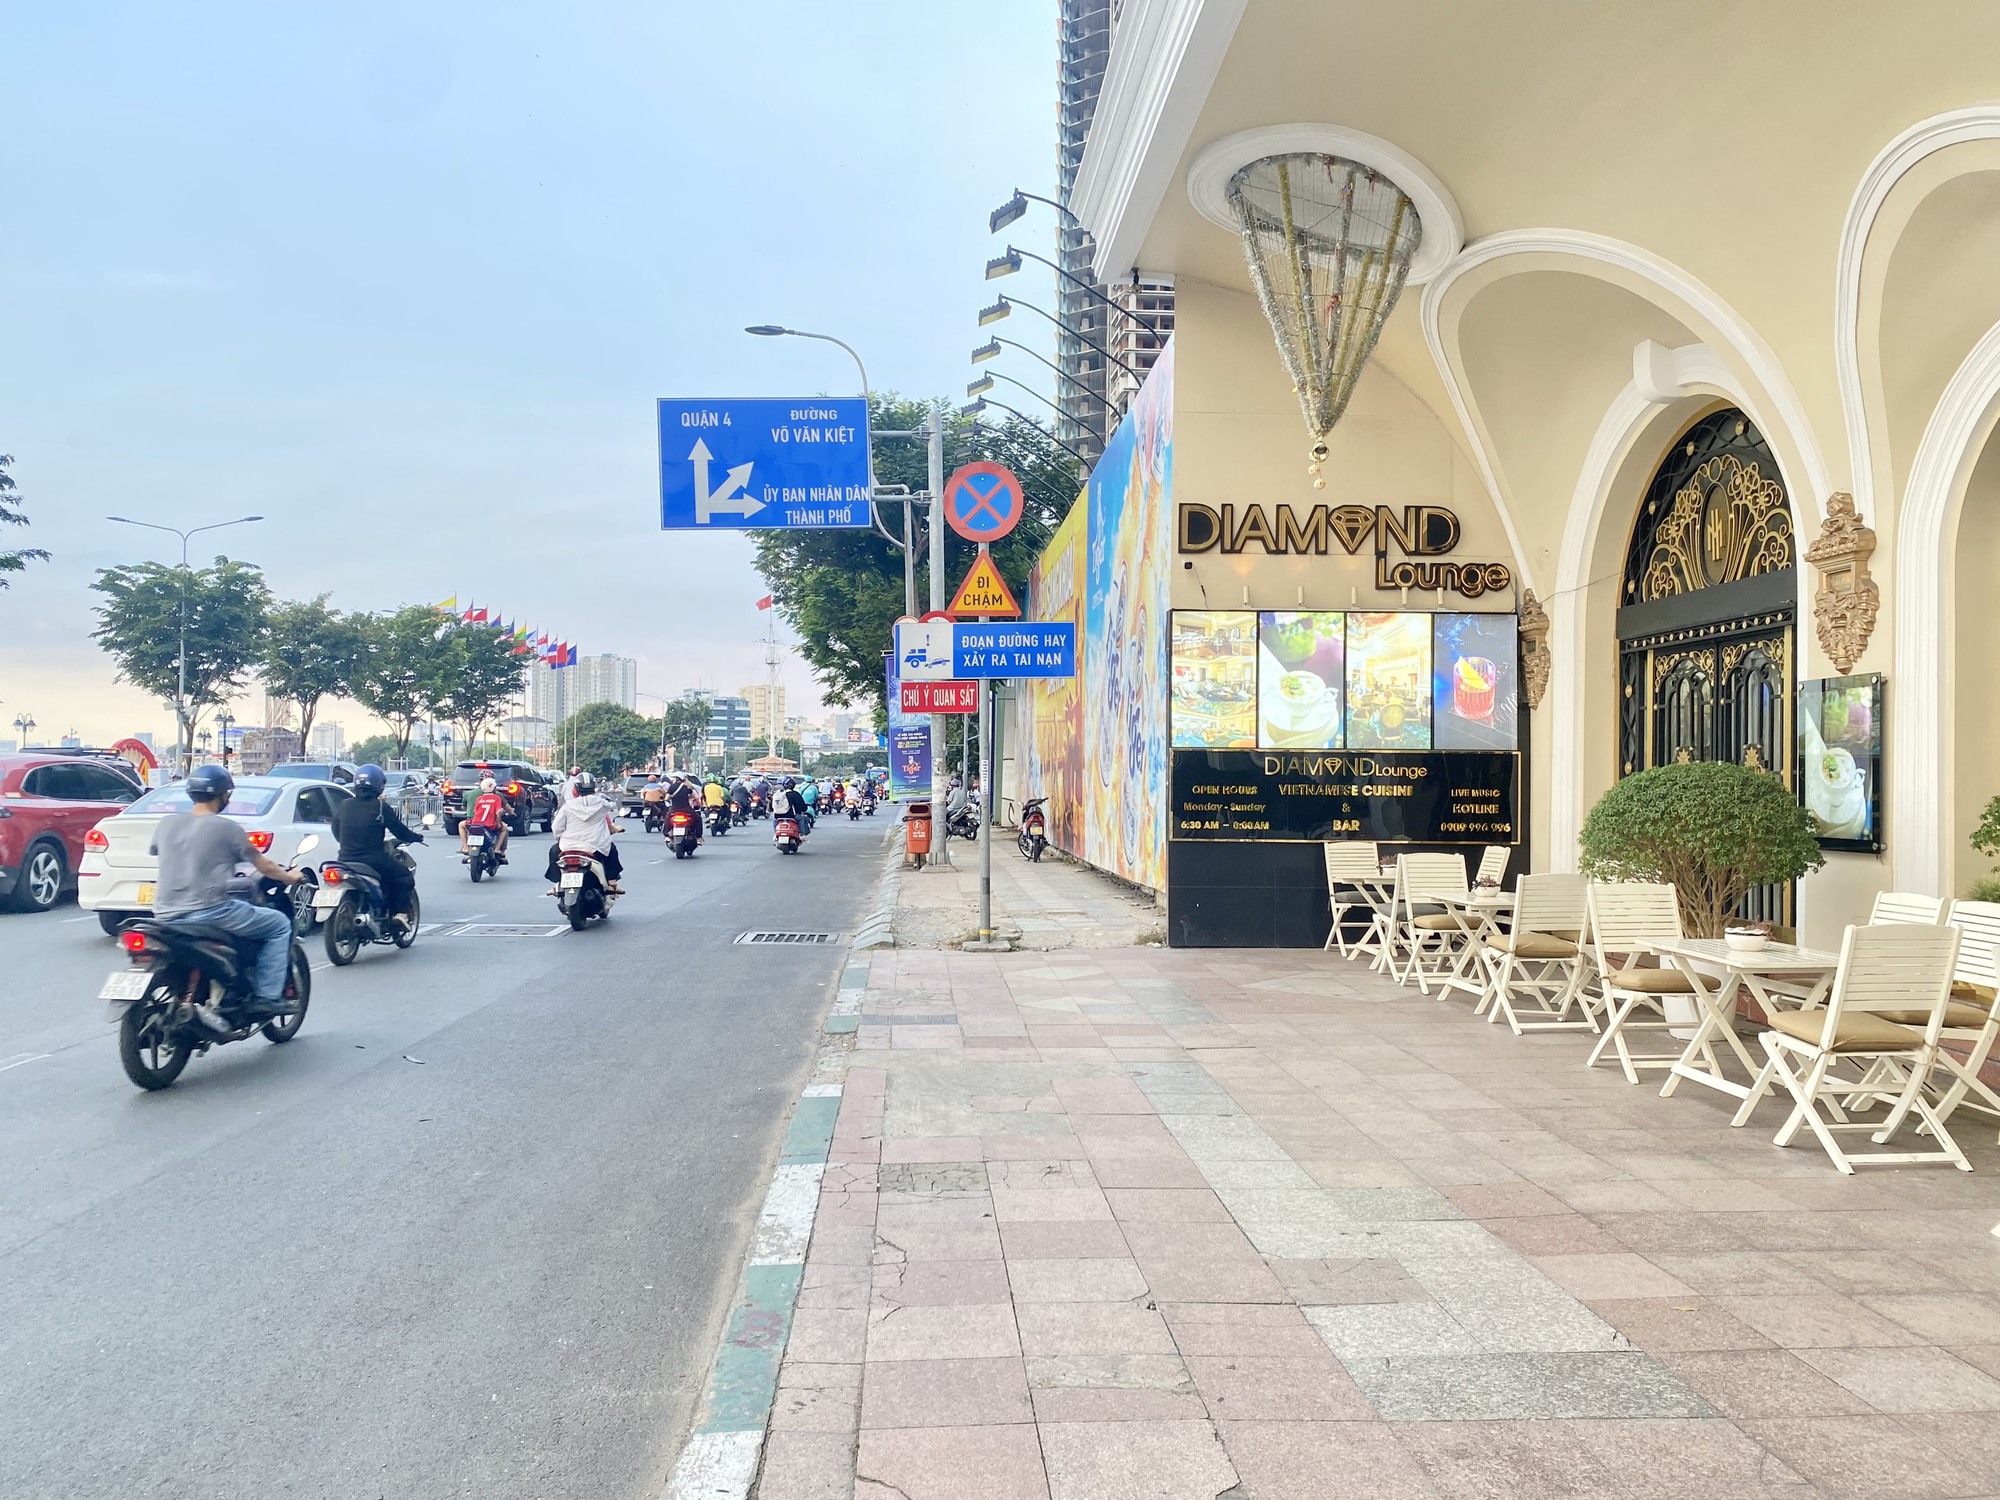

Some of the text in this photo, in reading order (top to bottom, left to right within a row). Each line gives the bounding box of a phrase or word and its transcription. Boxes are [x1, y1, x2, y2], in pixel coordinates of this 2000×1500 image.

[681, 410, 732, 429] QUẬN 4
[790, 406, 838, 420] ĐƯỜNG
[771, 425, 855, 445] VÕ VĂN KIỆT
[763, 484, 869, 502] ỦY BAN NHÂN DÂN
[785, 504, 852, 525] THÀNH PHỐ
[1178, 502, 1461, 556] DIAMOND
[976, 576, 990, 589] ĐI
[1375, 556, 1510, 598] Lounge
[963, 591, 1003, 609] CHẬM
[961, 633, 1067, 652] ĐOẠN ĐƯỜNG HAY
[963, 650, 1062, 668] XẢY RA TAI NẠN
[903, 684, 975, 707] CHÚ Ý QUAN SÁT
[1126, 678, 1146, 780] Tiger
[902, 764, 921, 775] Tiger
[1375, 763, 1428, 780] Lounge
[1192, 785, 1258, 795] OPEN HOURS
[1279, 784, 1414, 797] VIETNAMESE CUISINE
[1451, 788, 1501, 798] LIVE MUSIC
[480, 804, 491, 822] 7
[1183, 802, 1223, 812] Monday
[1230, 802, 1266, 813] Sunday
[1341, 802, 1351, 813] &
[1452, 803, 1499, 814] HOTLINE
[1180, 820, 1202, 830] 6:30
[1203, 820, 1220, 830] AM
[1332, 819, 1361, 831] BAR
[1440, 822, 1467, 832] 0909
